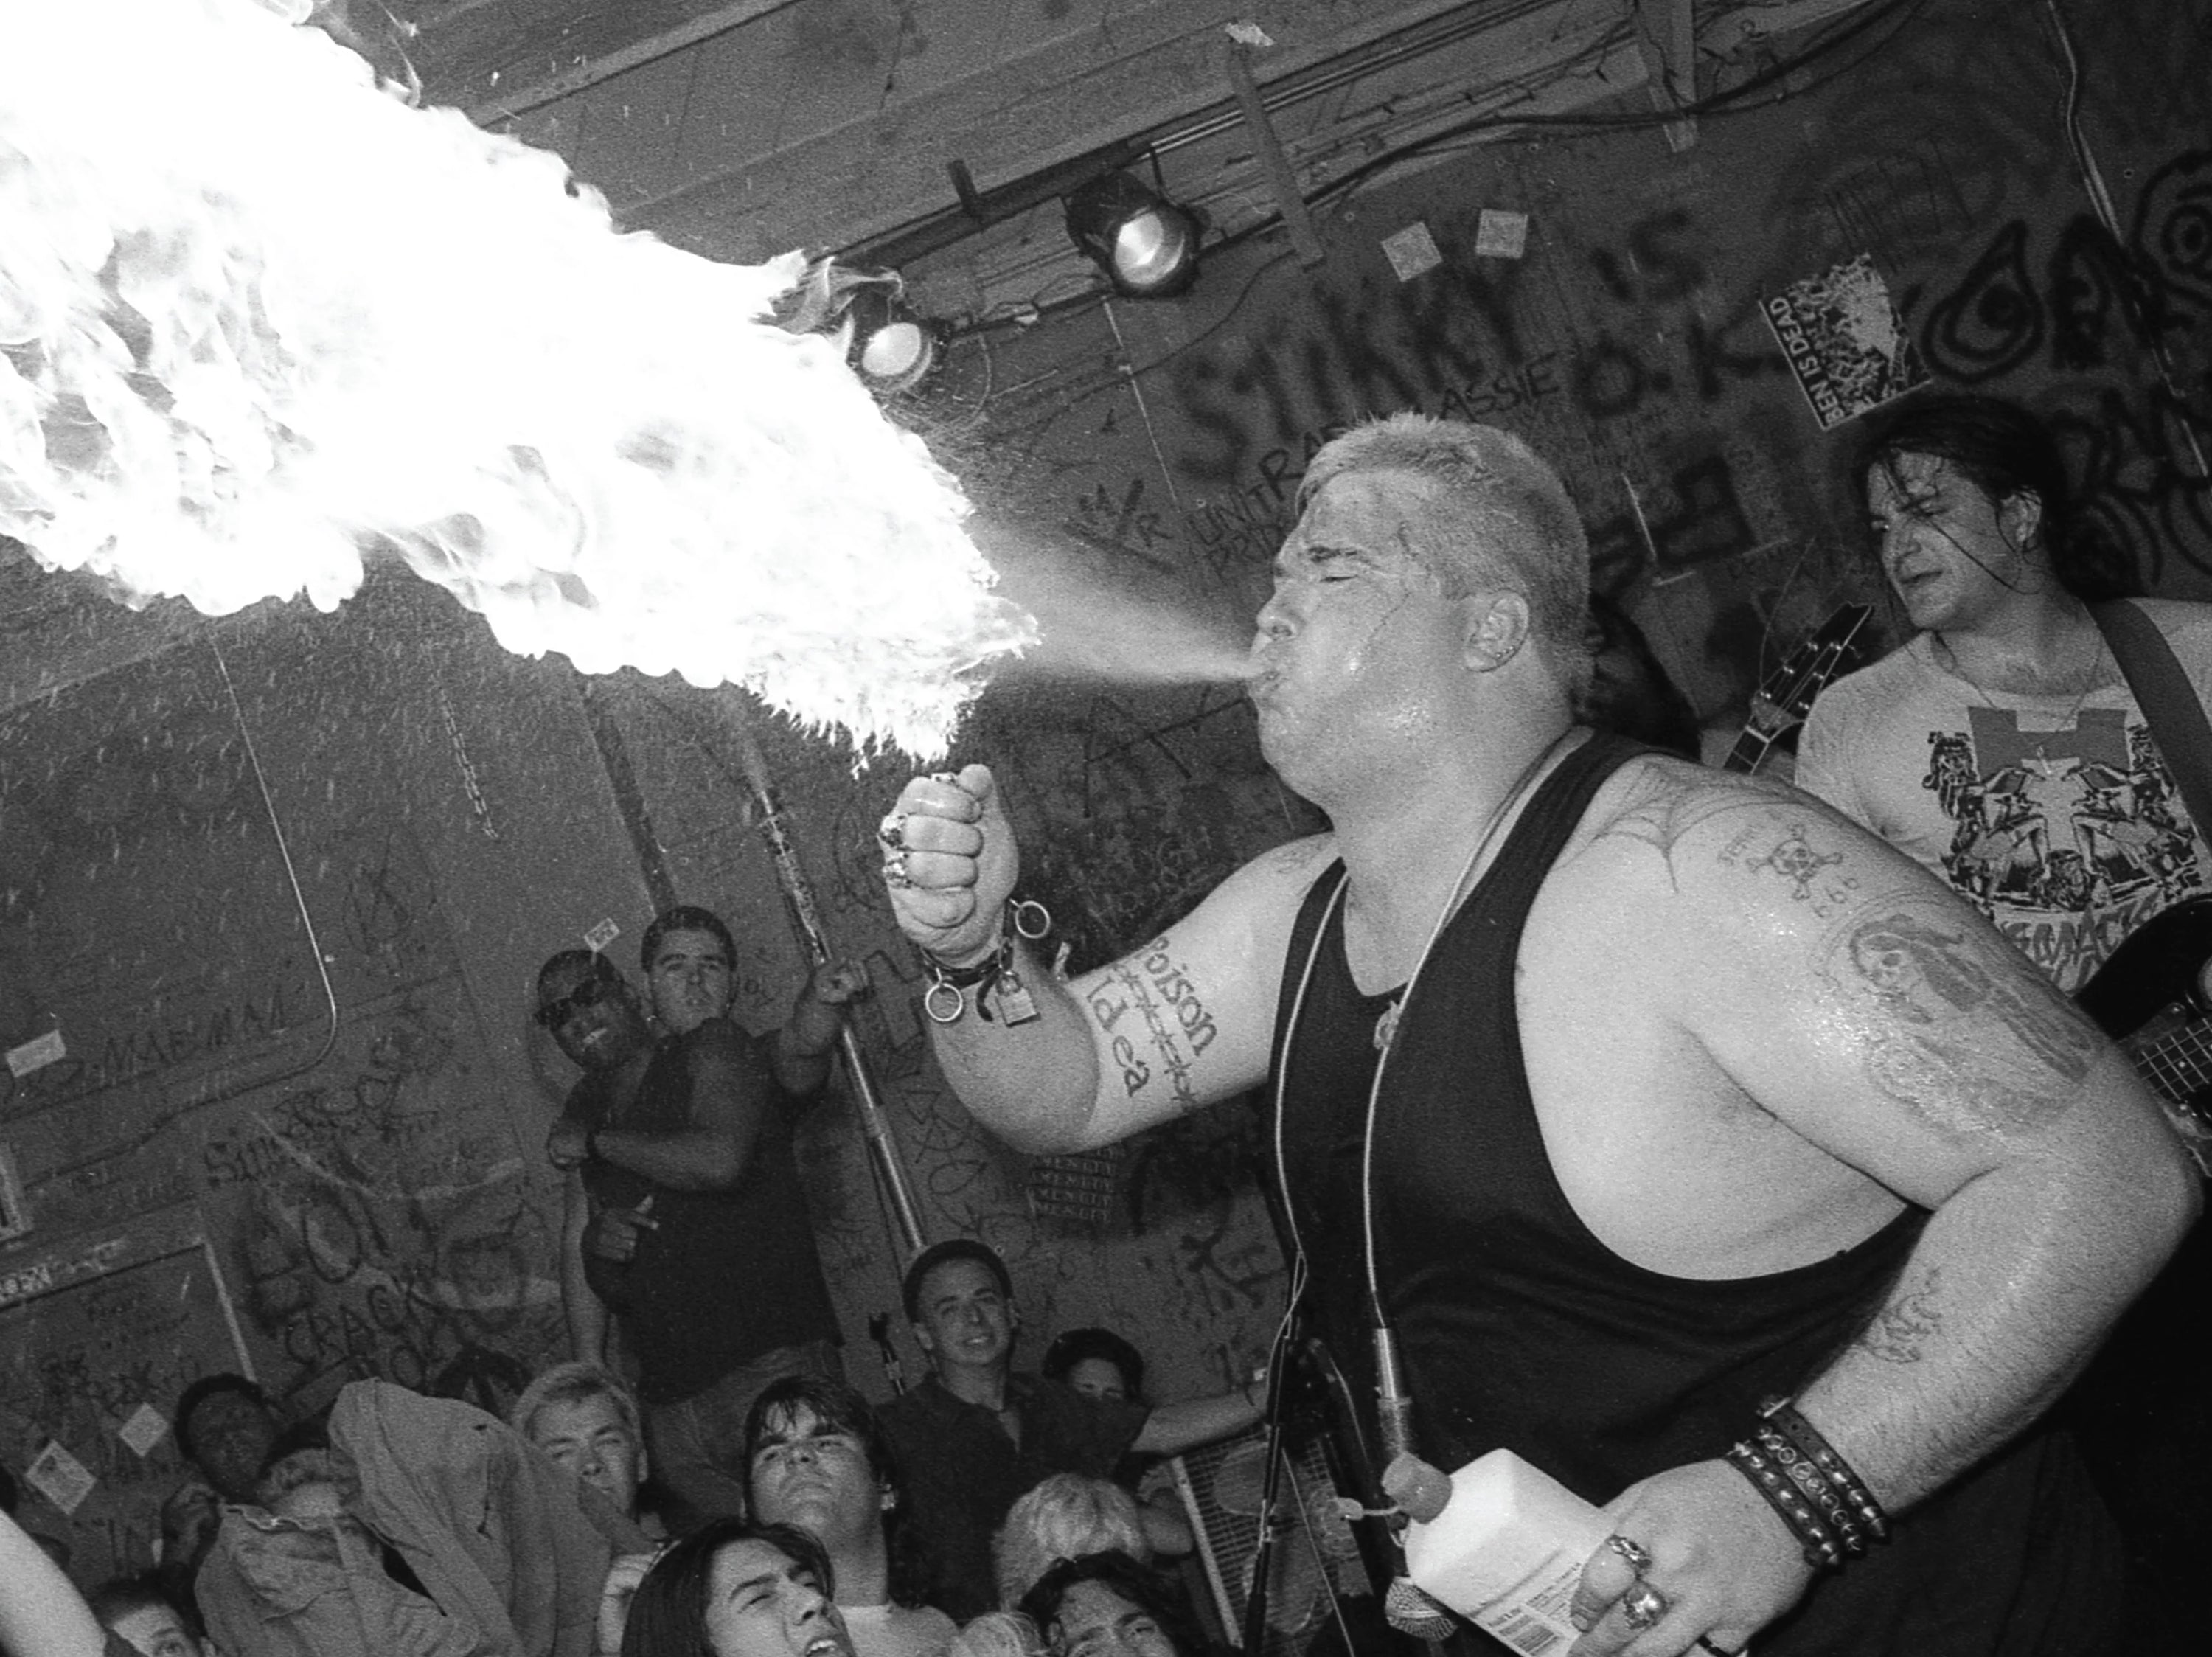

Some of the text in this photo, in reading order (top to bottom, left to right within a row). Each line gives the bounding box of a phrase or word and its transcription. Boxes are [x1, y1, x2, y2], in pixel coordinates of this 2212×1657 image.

[1590, 209, 1708, 301] IS
[1769, 296, 1845, 425] BEN IS DEAD
